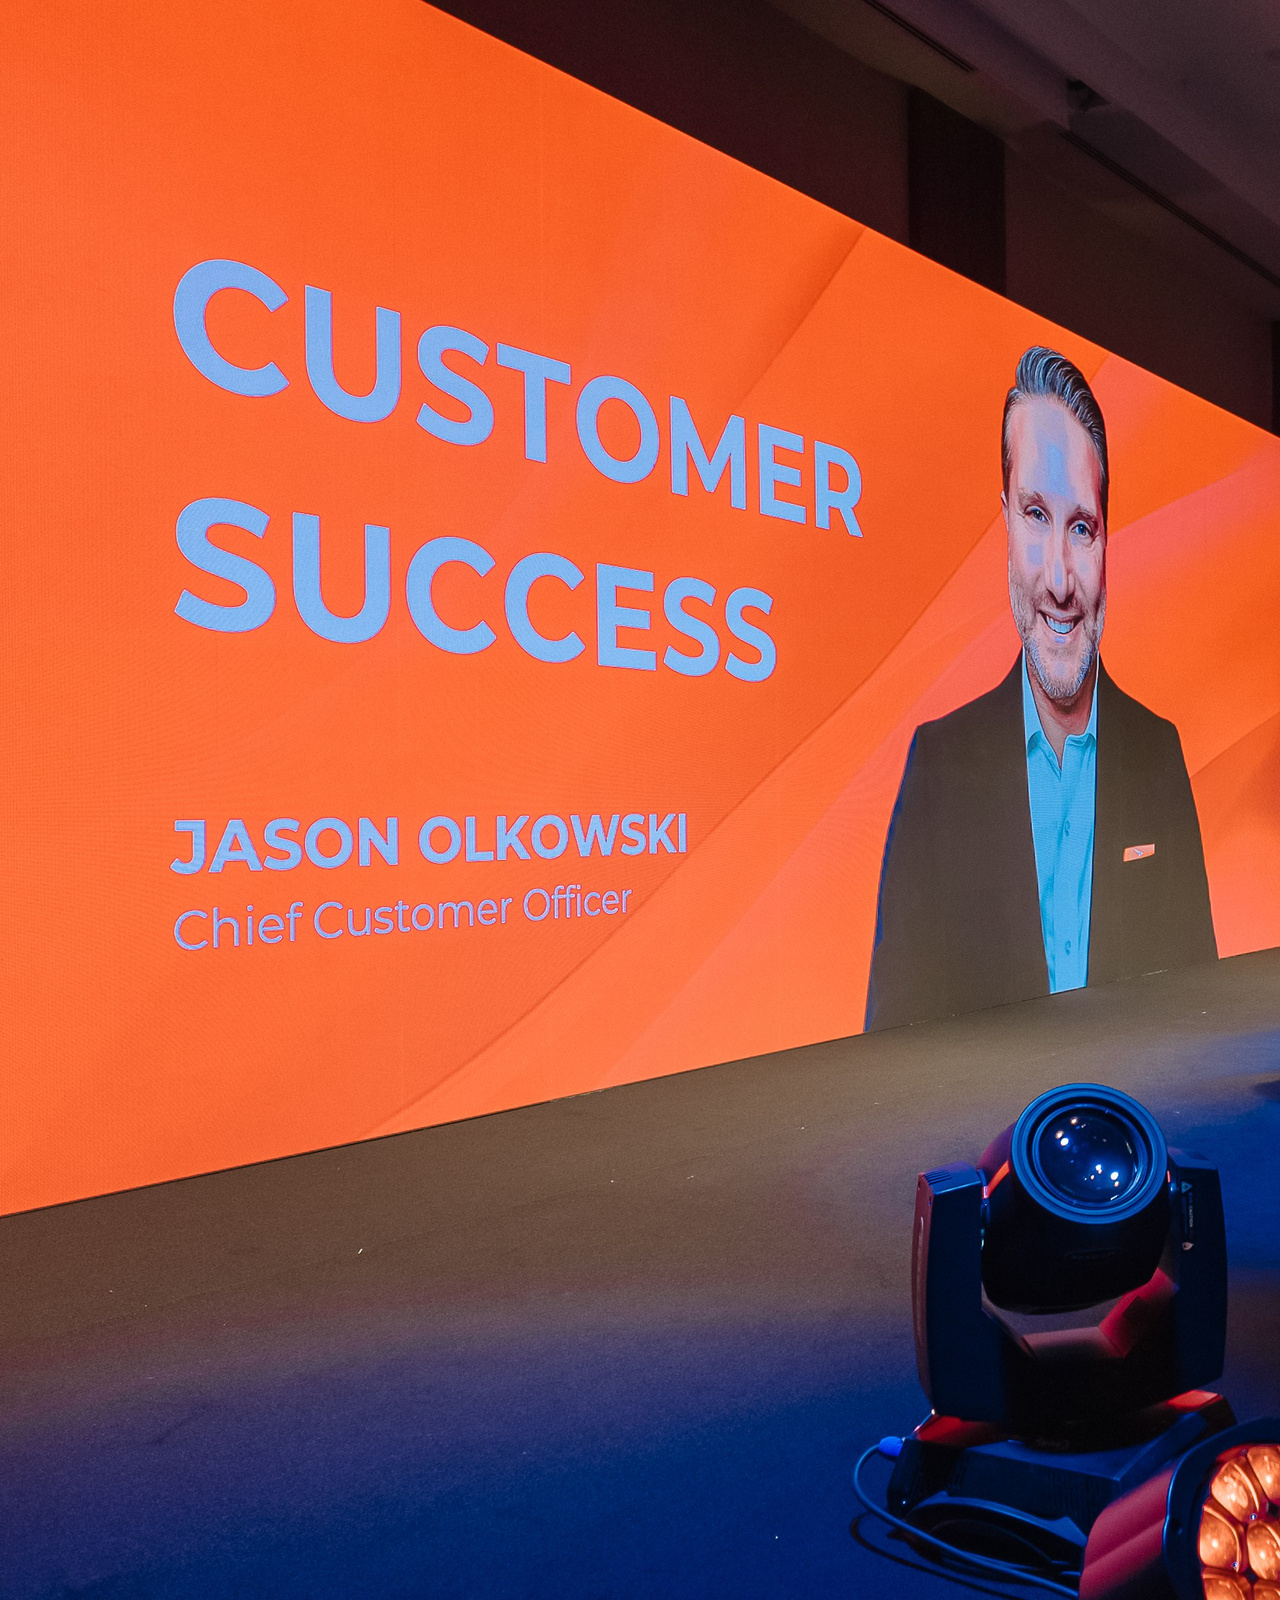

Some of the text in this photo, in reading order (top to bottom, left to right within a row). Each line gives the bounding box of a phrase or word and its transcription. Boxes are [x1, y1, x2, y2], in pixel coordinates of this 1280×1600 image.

[172, 258, 864, 539] CUSTOMER
[173, 496, 778, 684] SUCCESS
[169, 812, 688, 875] JASON OLKOWSKI
[173, 883, 634, 951] Chief Customer Officer
